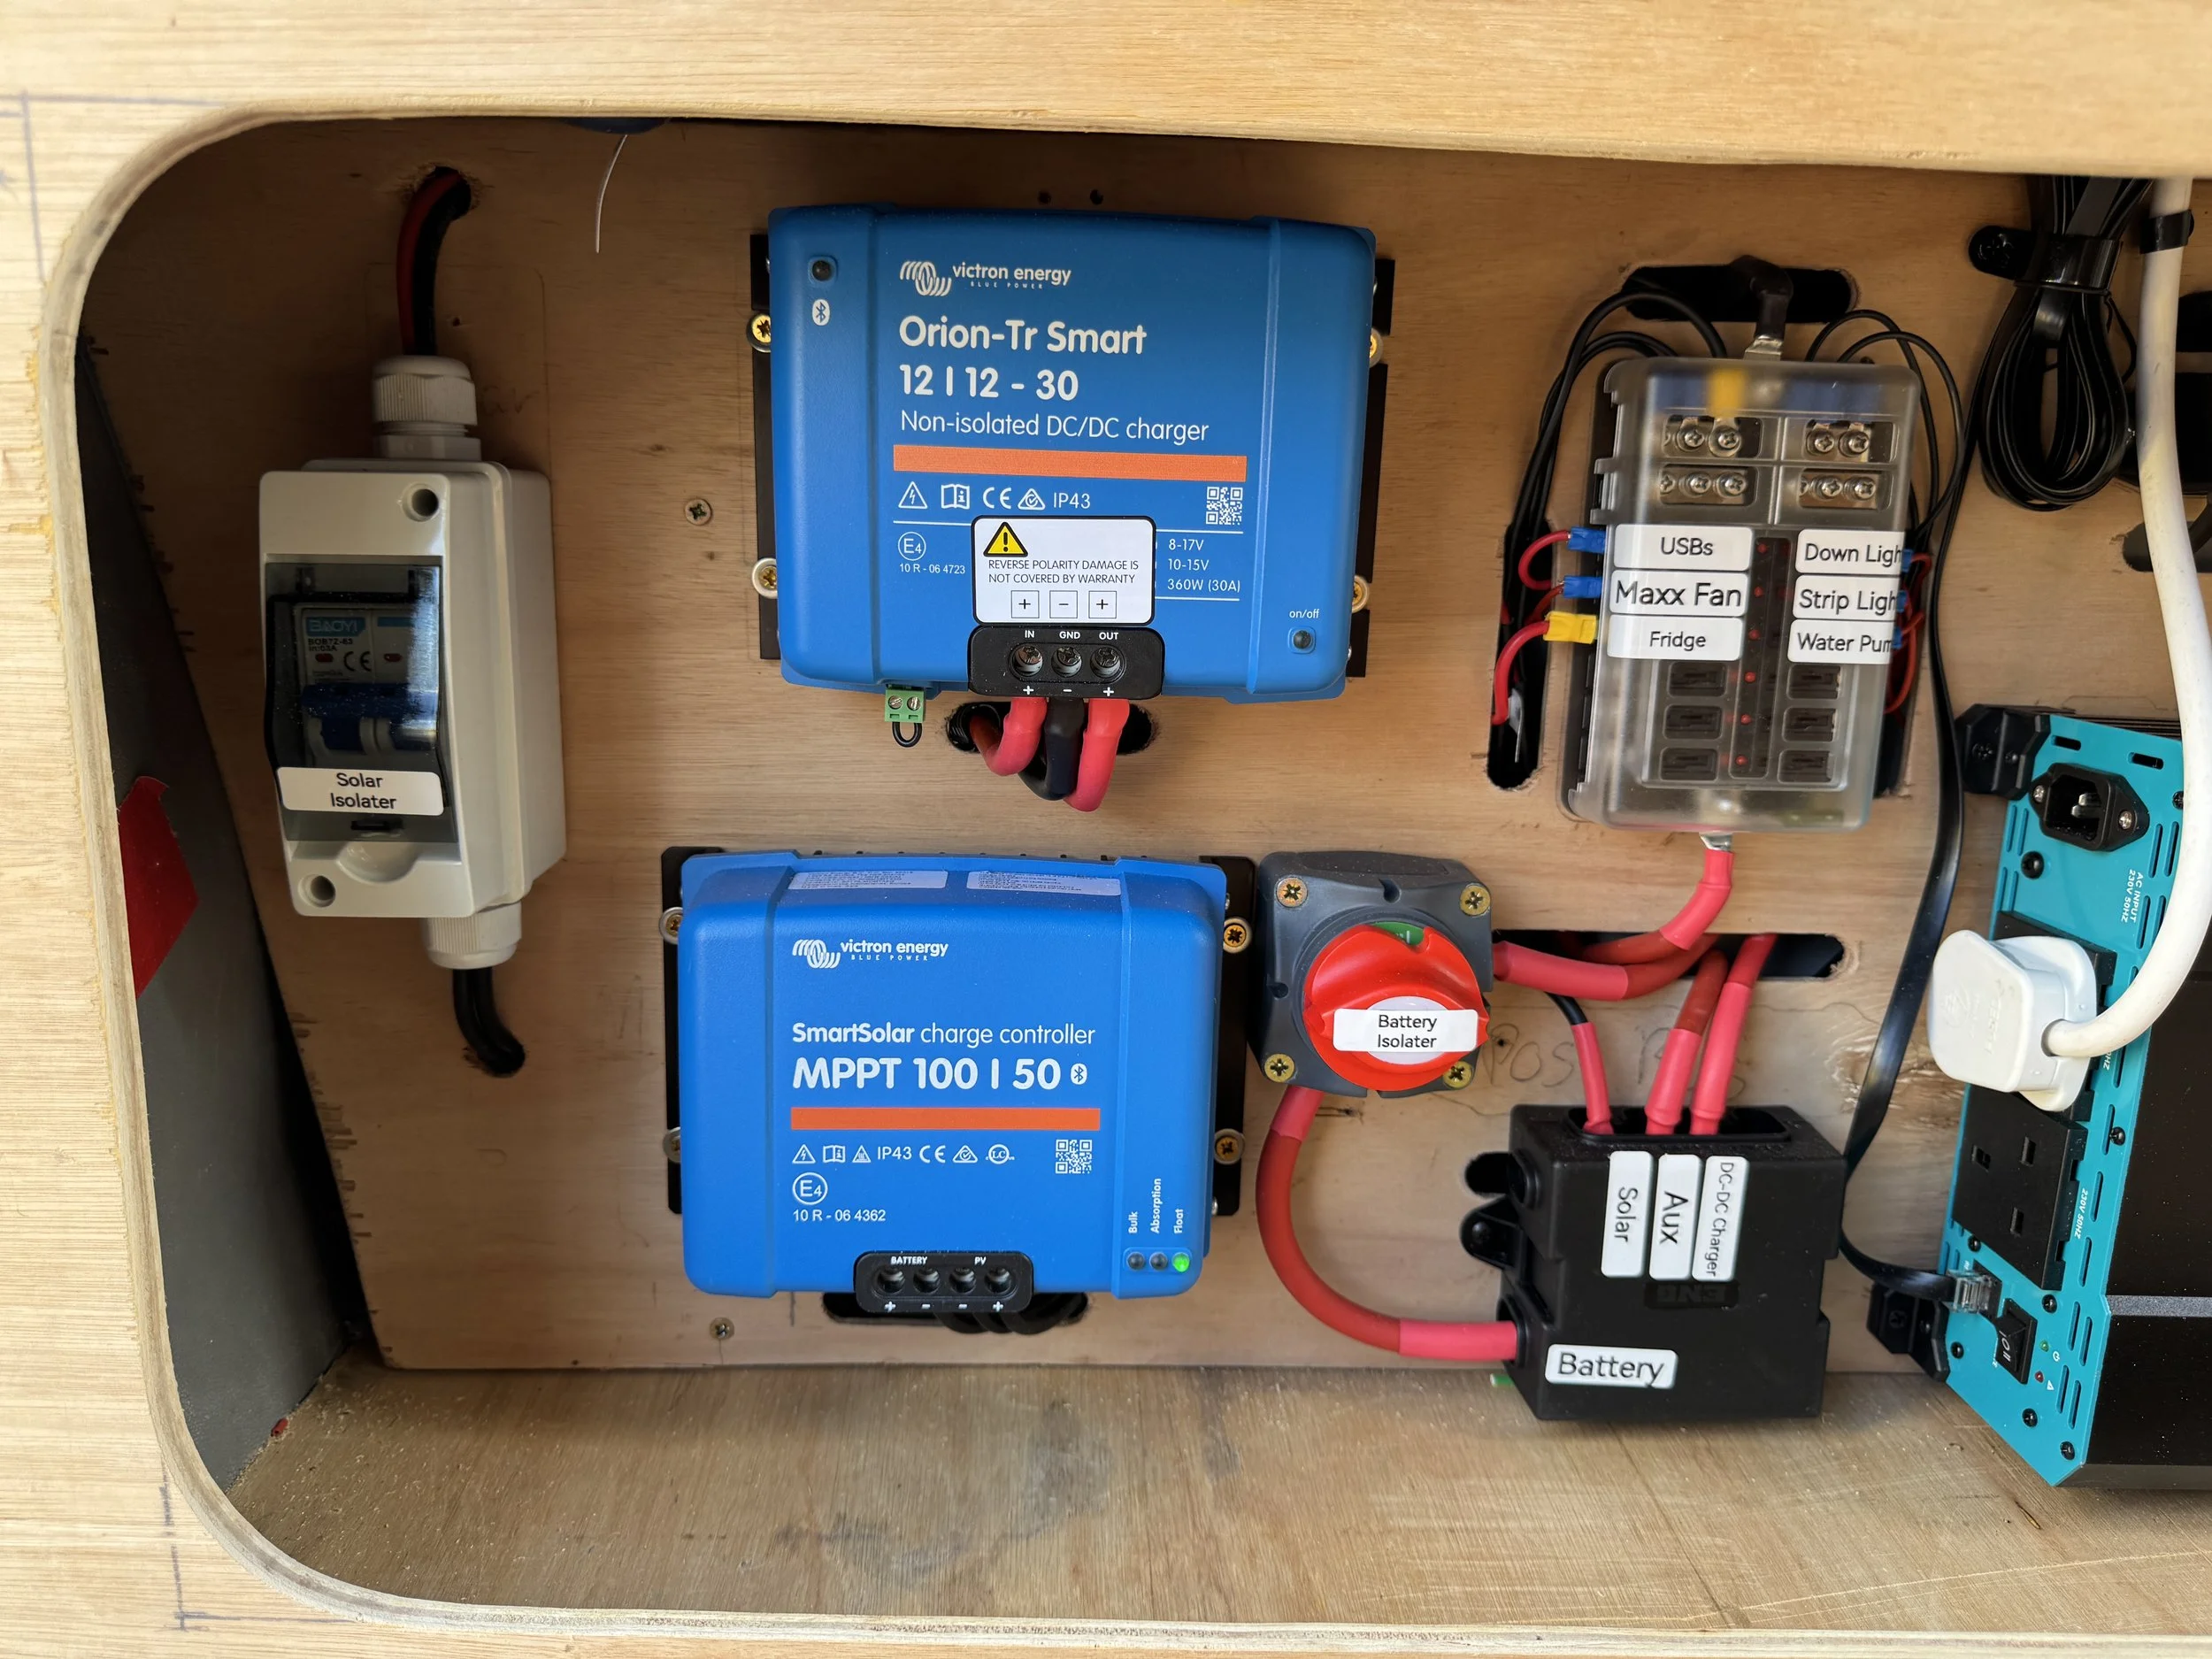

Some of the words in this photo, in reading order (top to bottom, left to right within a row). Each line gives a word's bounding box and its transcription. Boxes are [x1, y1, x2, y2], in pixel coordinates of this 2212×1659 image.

[952, 262, 1009, 280] victron
[1013, 268, 1071, 287] energy
[899, 315, 1038, 351] Orion-Tr
[1047, 320, 1148, 355] Smart
[899, 364, 933, 396] 12
[964, 366, 999, 398] 12
[1036, 369, 1079, 401] 30
[901, 410, 1040, 436] Non-isolated
[1047, 415, 1119, 439] DC/DC
[1125, 417, 1210, 446] charger
[1053, 492, 1092, 510] IP43
[1168, 538, 1204, 551] 8-17V
[1660, 536, 1715, 556] USBs
[1804, 542, 1860, 563] Down
[899, 563, 910, 573] 10
[913, 564, 921, 573] R
[929, 565, 941, 574] 06
[942, 565, 966, 575] 4723
[988, 559, 1030, 571] REVERSE
[1032, 559, 1080, 571] POLARITY
[1081, 560, 1129, 571] DAMAGE
[1130, 560, 1140, 571] IS
[1167, 558, 1210, 572] 10-15V
[988, 573, 1010, 584] NOT
[1013, 573, 1061, 585] COVERED
[1063, 573, 1076, 584] BY
[1078, 573, 1136, 584] WARRANTY
[1167, 578, 1204, 591] 360W
[1207, 580, 1241, 593] (30A)
[1615, 580, 1686, 606] Maxx
[1694, 582, 1742, 607] Fan
[1799, 588, 1850, 614] Strip
[1289, 608, 1320, 619] on/off
[1024, 629, 1035, 639] IN
[1058, 630, 1081, 640] GND
[1098, 632, 1119, 641] OUT
[1648, 631, 1707, 651] Fridge
[1797, 632, 1855, 652] Water
[336, 772, 383, 788] Solar
[330, 792, 397, 809] Isolater
[2126, 869, 2136, 895] 230V
[2135, 872, 2144, 888] AC
[2120, 896, 2131, 923] 50HZ
[2129, 890, 2141, 923] INPUT
[840, 938, 892, 955] victron
[895, 941, 949, 958] energy
[1378, 1014, 1437, 1033] Battery
[792, 1022, 916, 1044] SmartSolar
[920, 1022, 993, 1049] charge
[999, 1023, 1096, 1045] controller
[1377, 1033, 1437, 1048] Isolater
[792, 1056, 902, 1090] MPPT
[912, 1056, 979, 1090] 100
[1011, 1057, 1063, 1091] 50
[877, 1146, 913, 1161] IP43
[1715, 1162, 1734, 1214] DC-DC
[1150, 1178, 1164, 1234] Absorption
[2078, 1187, 2088, 1214] 230V
[793, 1209, 809, 1222] 10
[812, 1209, 823, 1222] R
[834, 1210, 851, 1222] 06
[853, 1209, 887, 1222] 4362
[1127, 1210, 1139, 1234] Bulk
[1173, 1208, 1184, 1234] Float
[1614, 1186, 1639, 1243] Solar
[1659, 1190, 1689, 1245] Aux
[2074, 1213, 2085, 1240] 50HZ
[1704, 1217, 1727, 1277] Charger
[890, 1256, 928, 1265] BATTERY
[974, 1256, 987, 1266] PV
[1557, 1351, 1665, 1387] Battery
